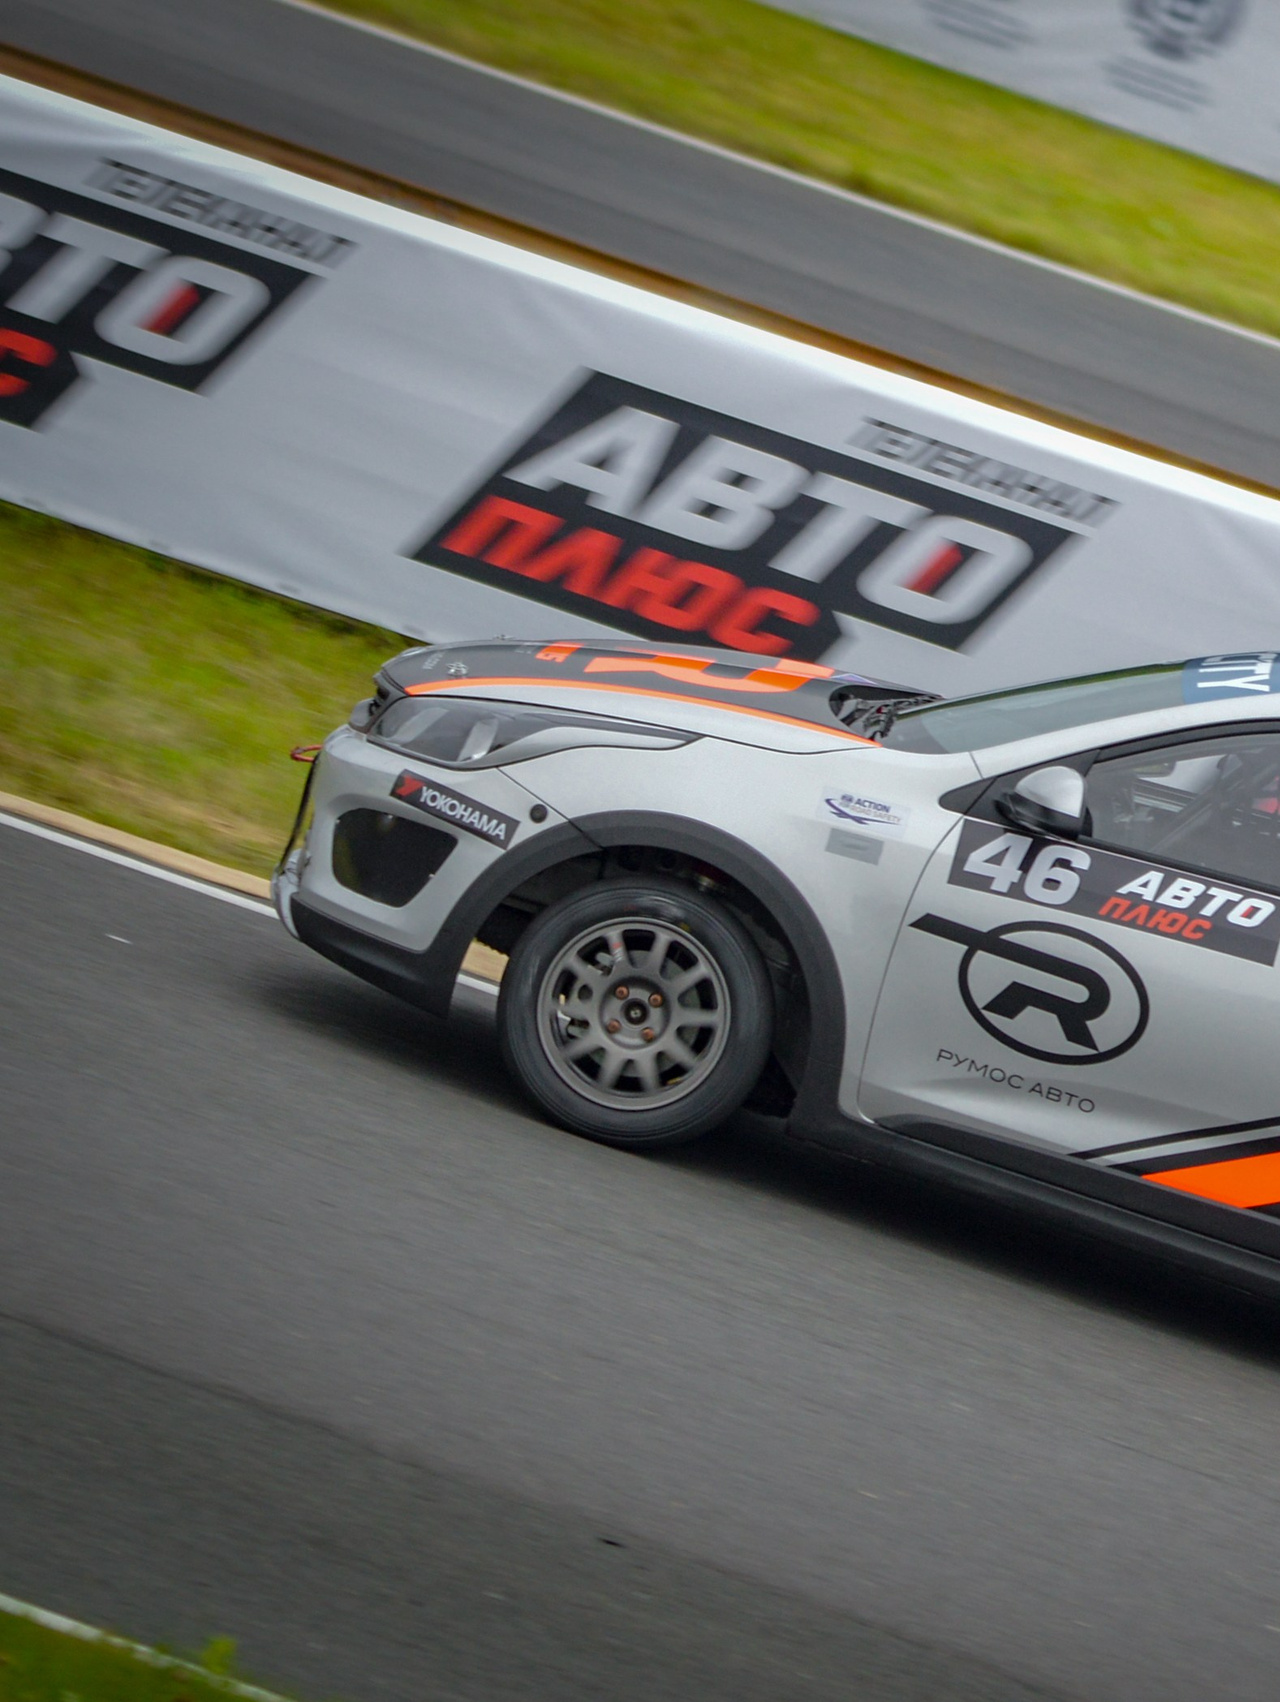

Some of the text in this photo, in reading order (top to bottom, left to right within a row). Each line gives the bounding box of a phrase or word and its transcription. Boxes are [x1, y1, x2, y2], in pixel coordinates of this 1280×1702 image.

[502, 405, 1034, 625] АВТО
[440, 495, 820, 656] ПЛЮС
[419, 786, 507, 840] YOKOHAMA
[854, 798, 891, 813] ACTION
[963, 831, 1092, 905] 46
[1116, 870, 1276, 928] АВТО
[1098, 897, 1213, 941] ПЛЮС
[936, 1048, 1096, 1114] РУМОС АВТО
